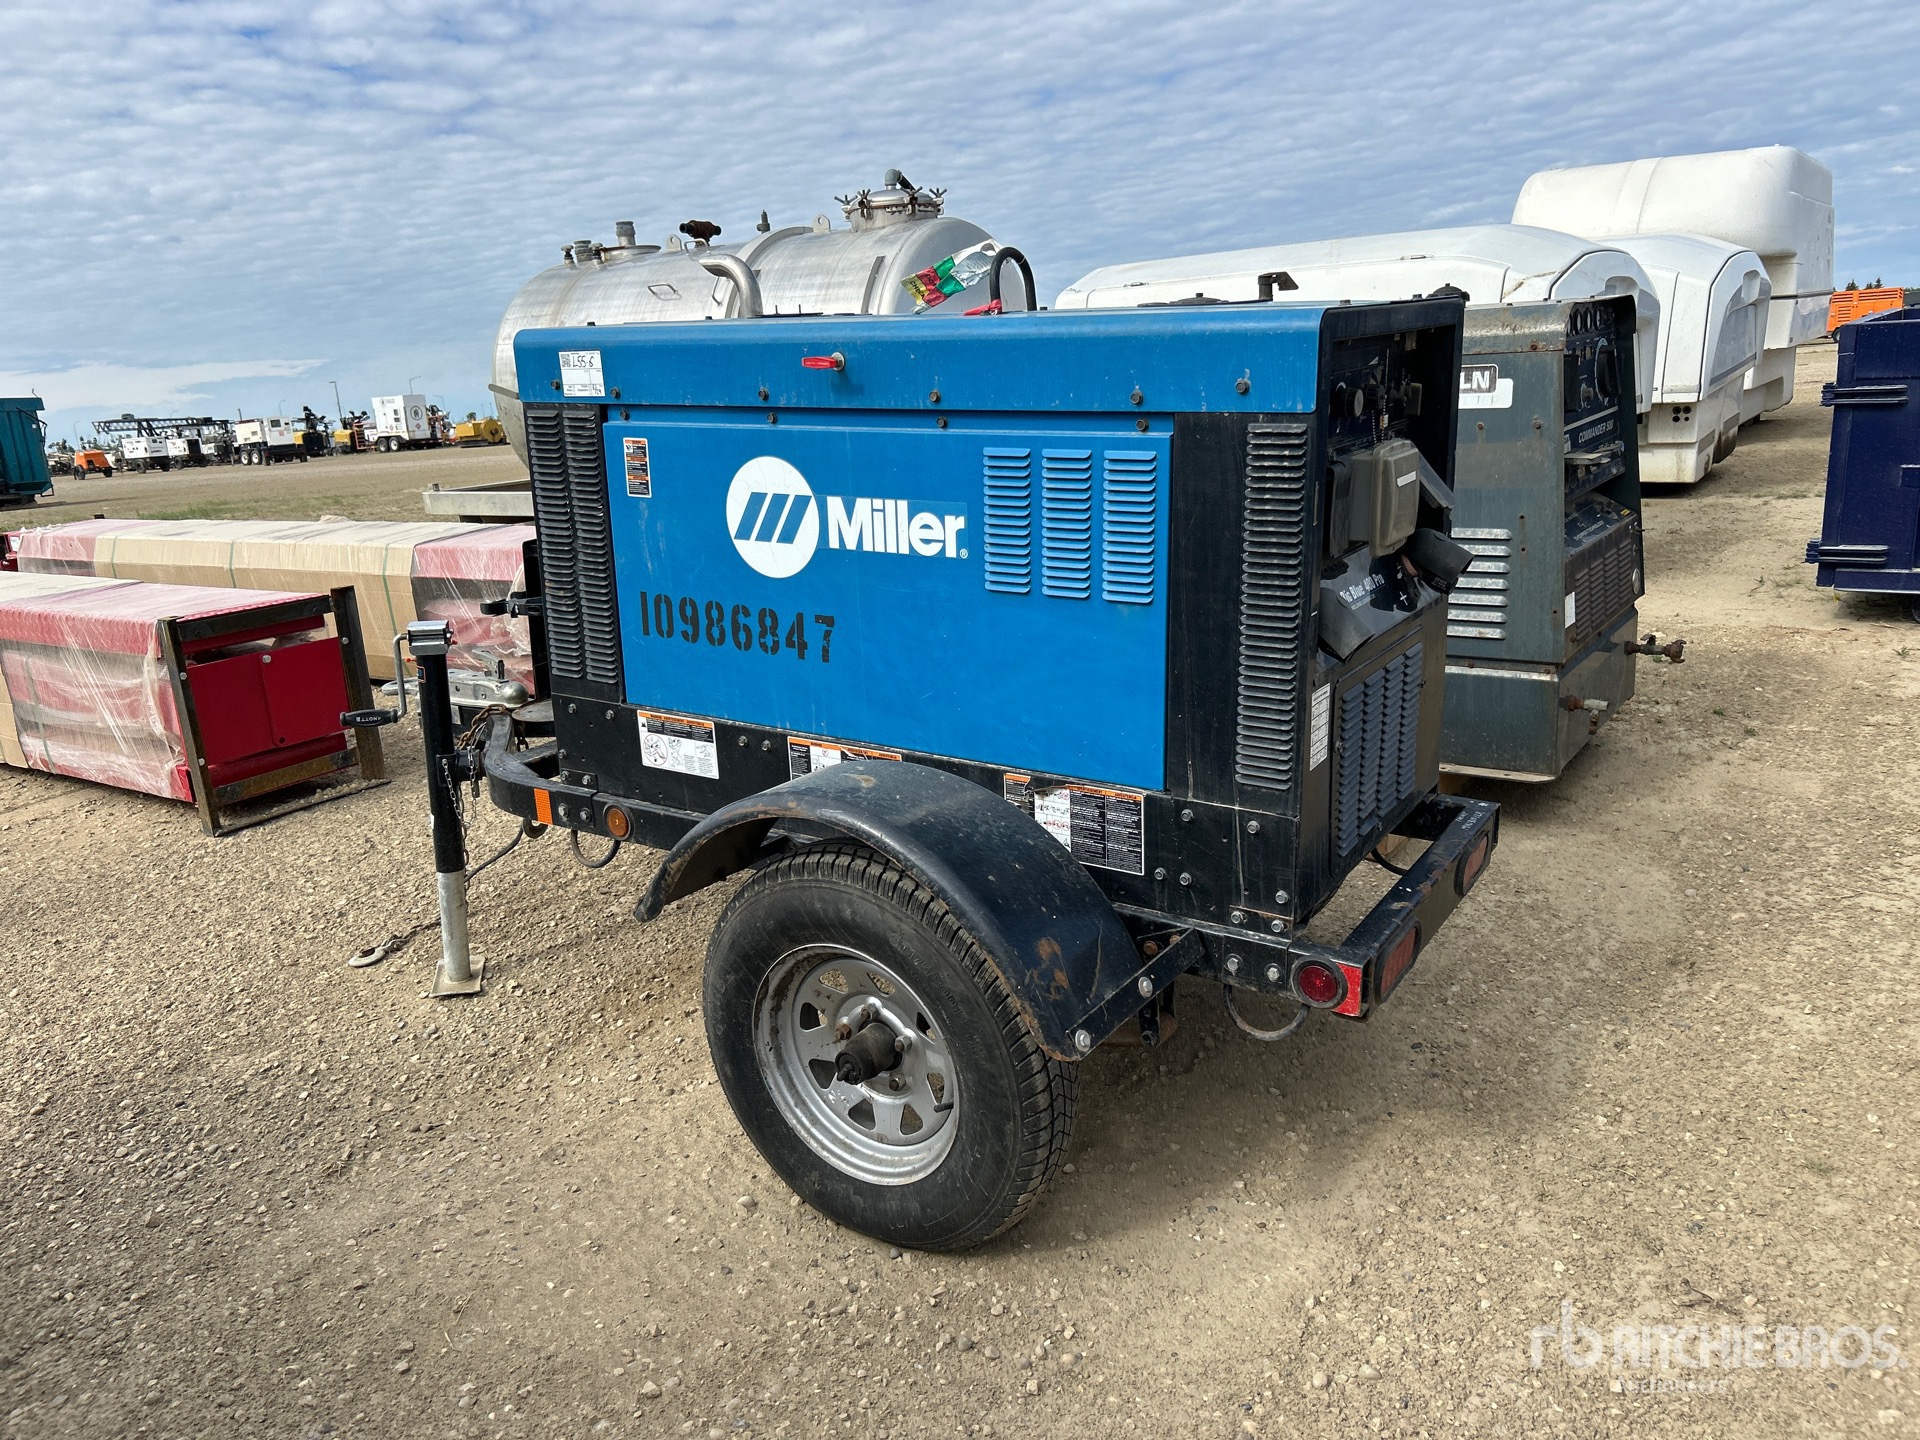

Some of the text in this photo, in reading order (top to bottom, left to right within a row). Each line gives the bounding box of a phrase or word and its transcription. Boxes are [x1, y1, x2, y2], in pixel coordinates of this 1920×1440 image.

[1349, 584, 1365, 600] Blue
[1372, 573, 1385, 587] Pro
[640, 591, 835, 663] 10986847
